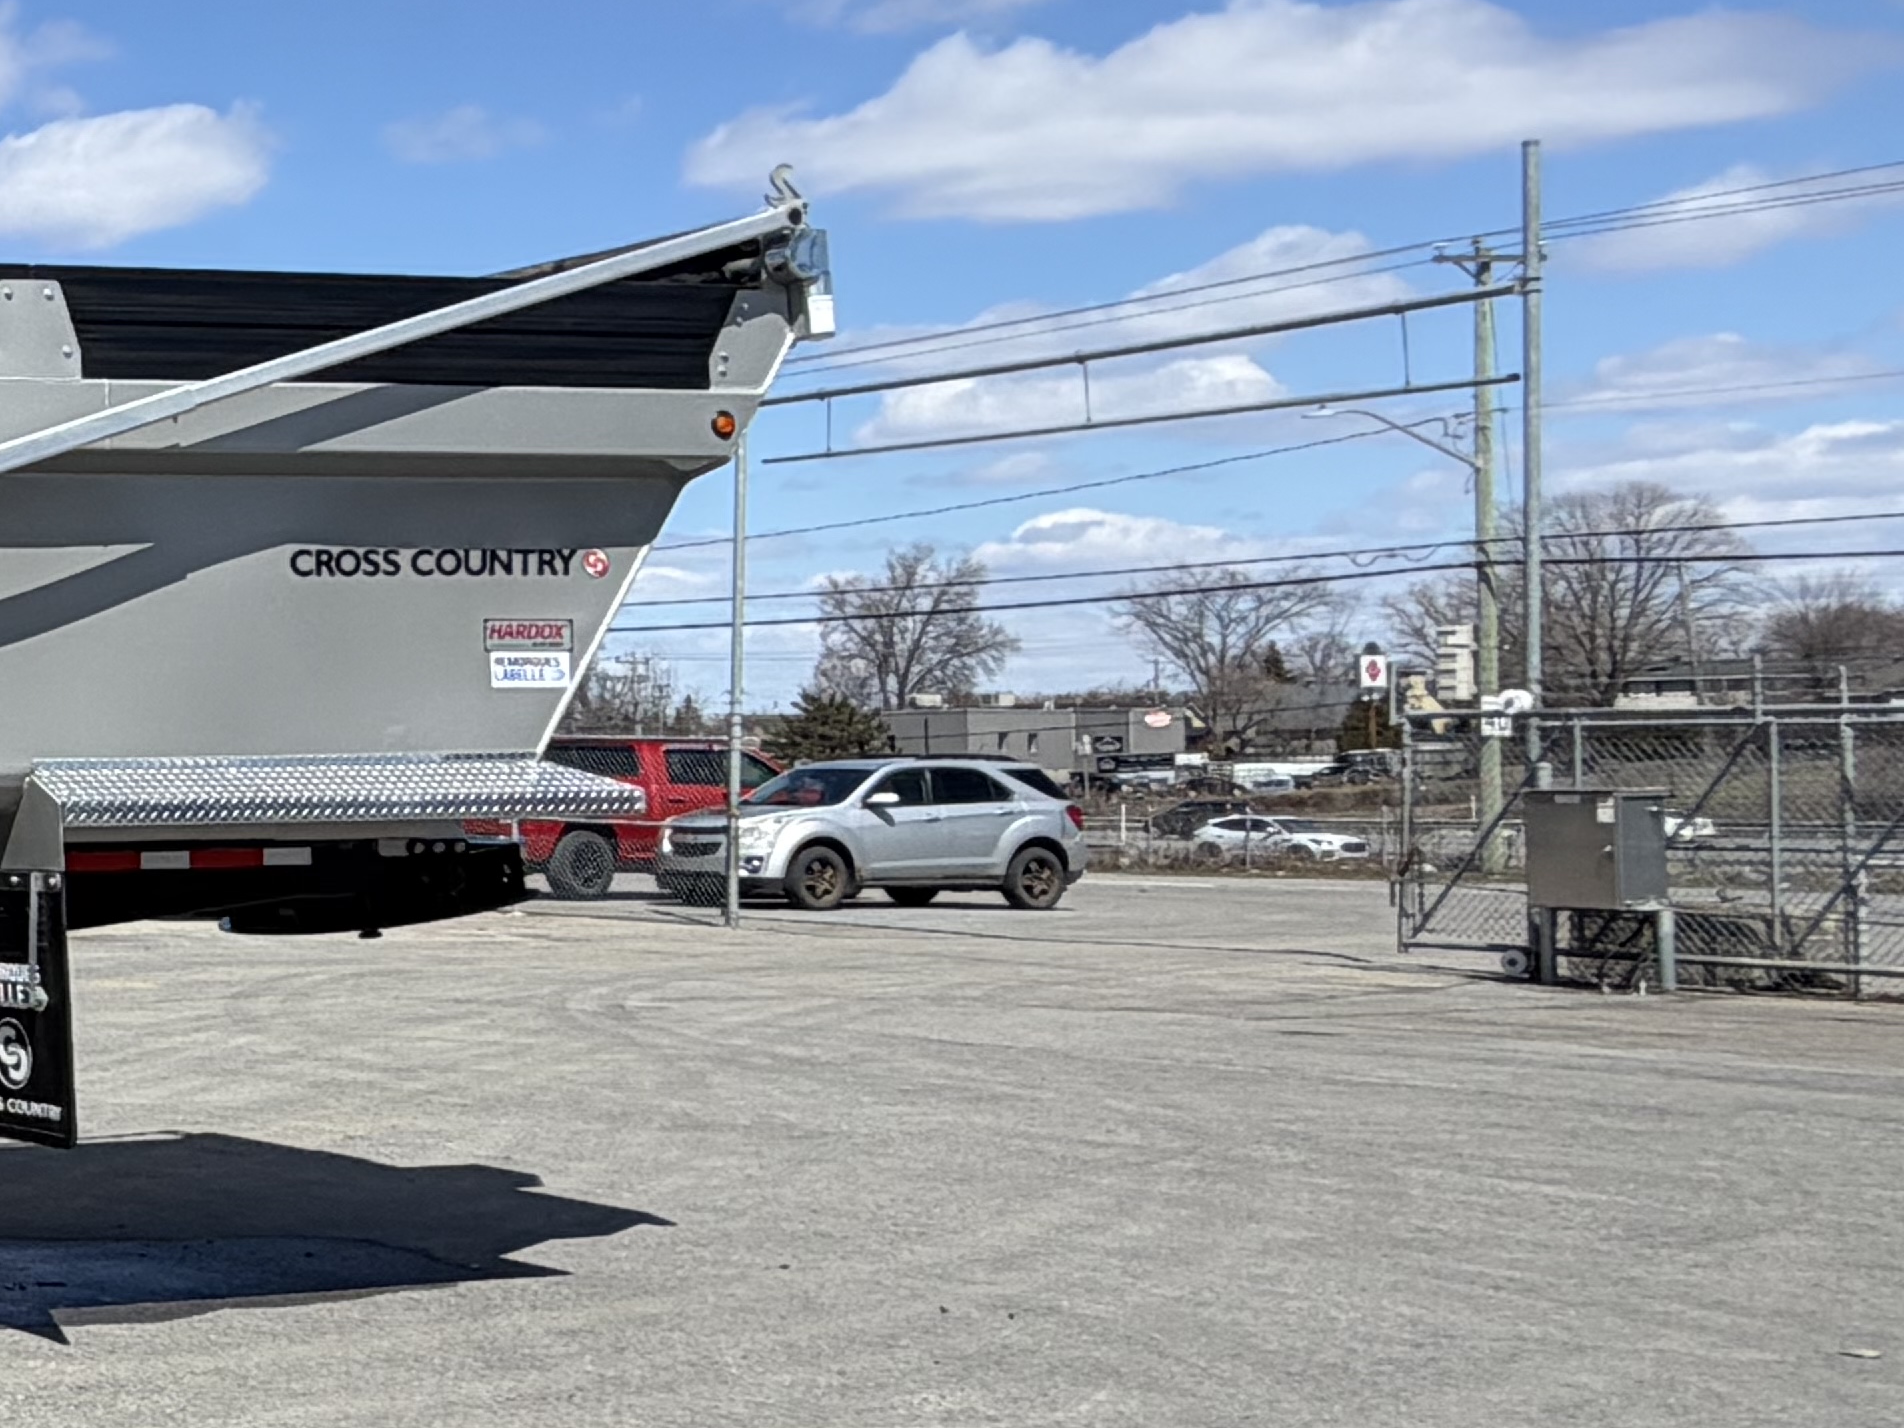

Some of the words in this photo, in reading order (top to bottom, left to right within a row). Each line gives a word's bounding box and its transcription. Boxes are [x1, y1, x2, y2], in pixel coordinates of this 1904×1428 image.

[290, 548, 401, 577] CROSS
[410, 548, 578, 577] COUNTRY
[488, 623, 567, 640] HARDOX
[7, 1097, 62, 1122] COUNTRY
